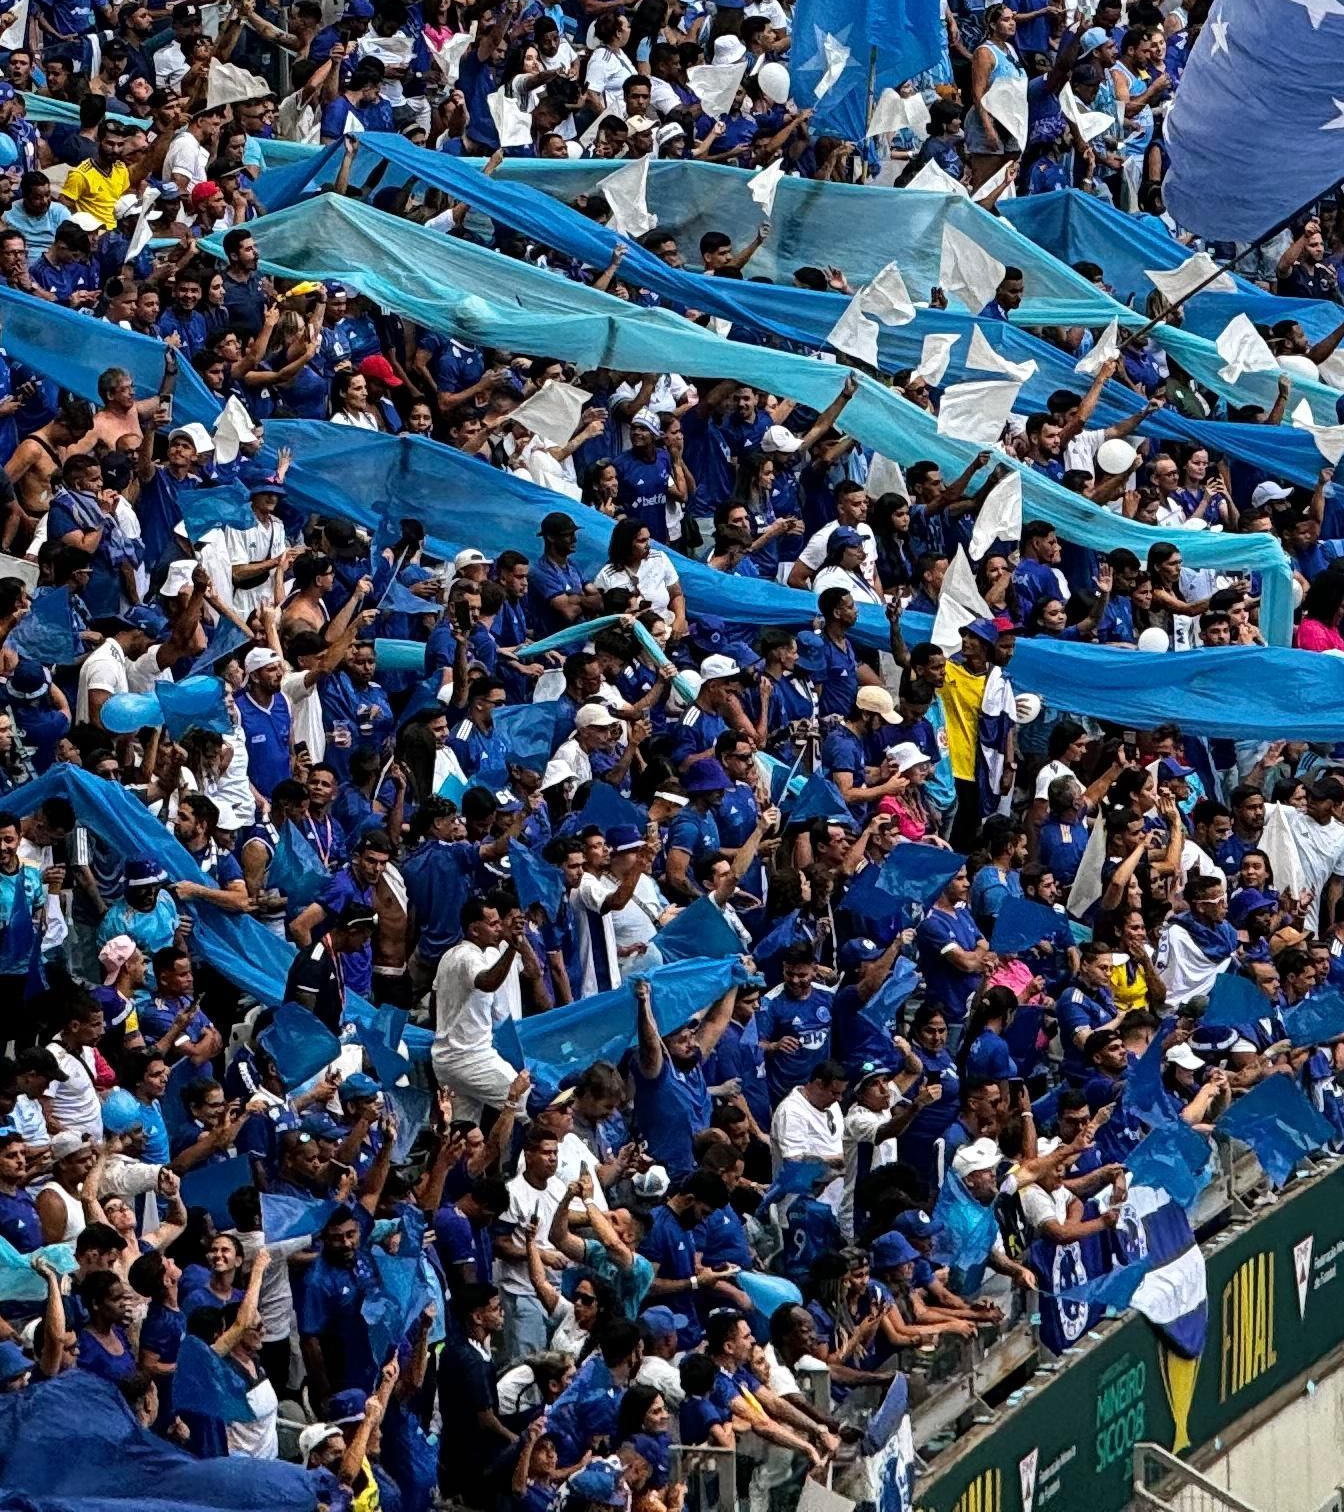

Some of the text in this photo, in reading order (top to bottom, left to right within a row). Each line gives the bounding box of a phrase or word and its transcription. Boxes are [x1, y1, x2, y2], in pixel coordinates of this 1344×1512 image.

[1219, 1250, 1278, 1405] FINAL
[1096, 1360, 1146, 1430] MINEIRO
[1096, 1401, 1145, 1473] SICOOB
